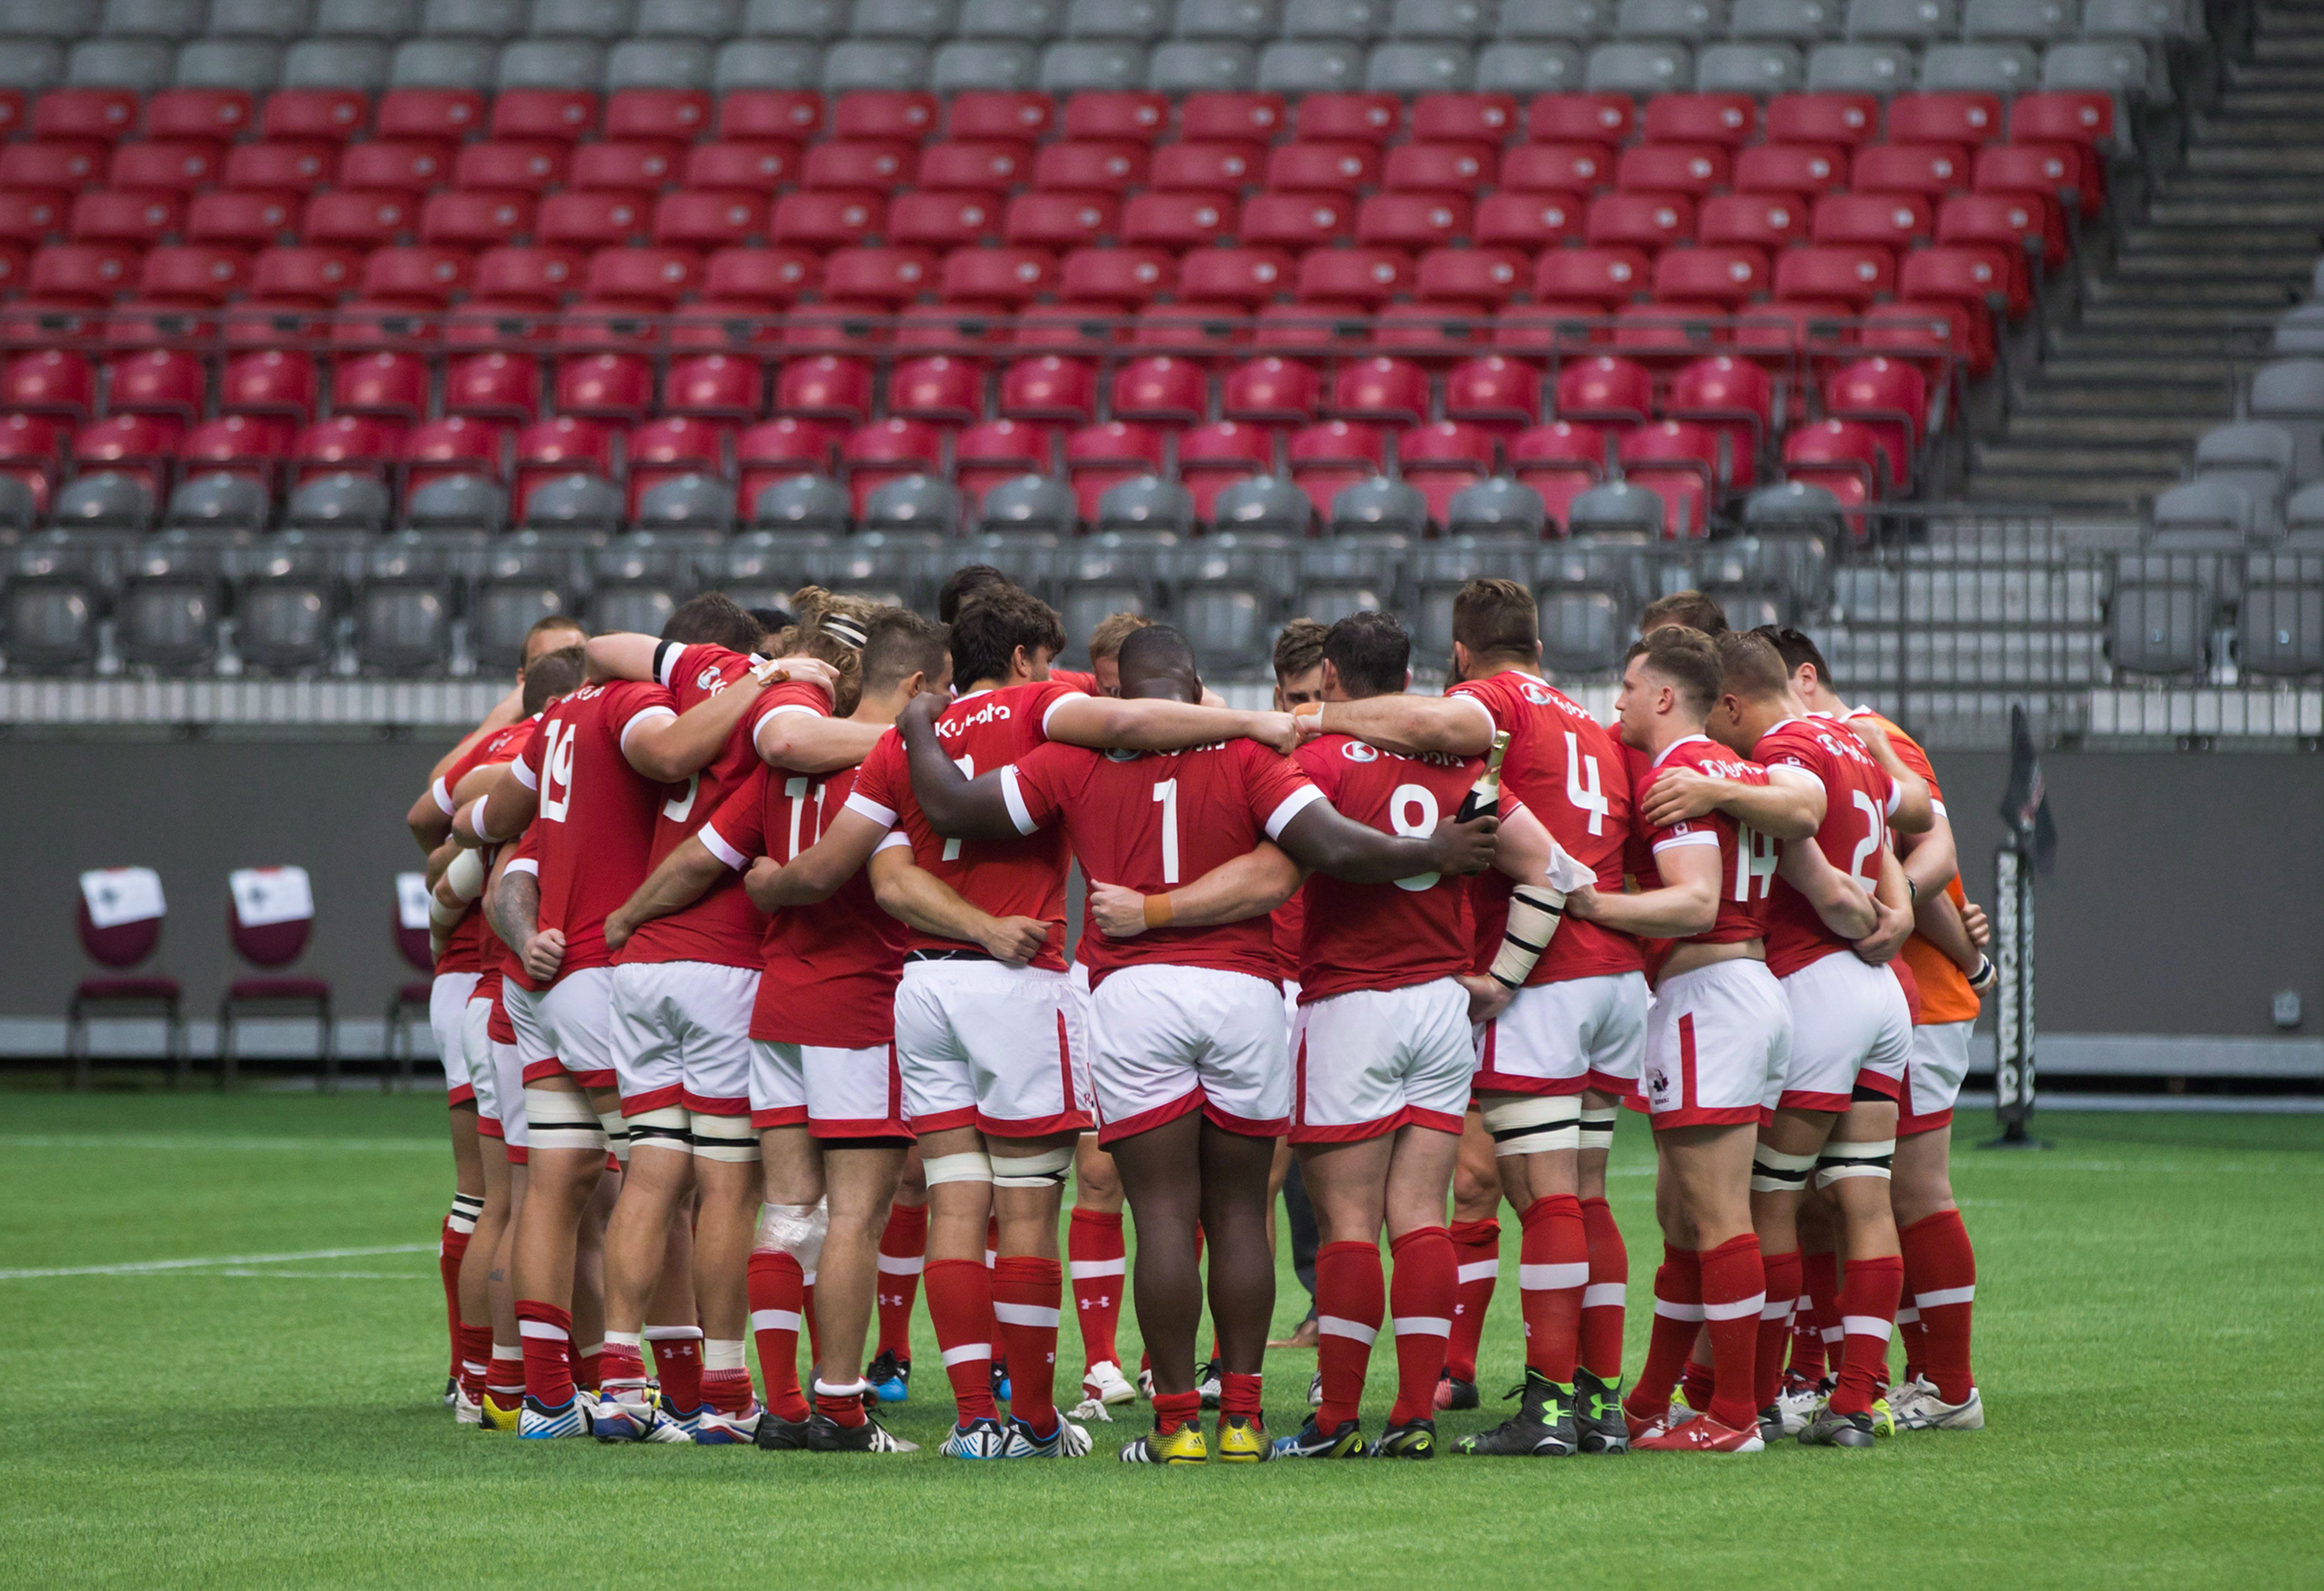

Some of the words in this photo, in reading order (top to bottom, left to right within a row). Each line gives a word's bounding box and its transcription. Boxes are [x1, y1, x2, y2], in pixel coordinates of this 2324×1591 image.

[540, 719, 576, 823] 19
[1565, 731, 1609, 836] 4
[1153, 778, 1179, 883] 1
[1391, 784, 1441, 891] 8
[1736, 821, 1778, 902] 14
